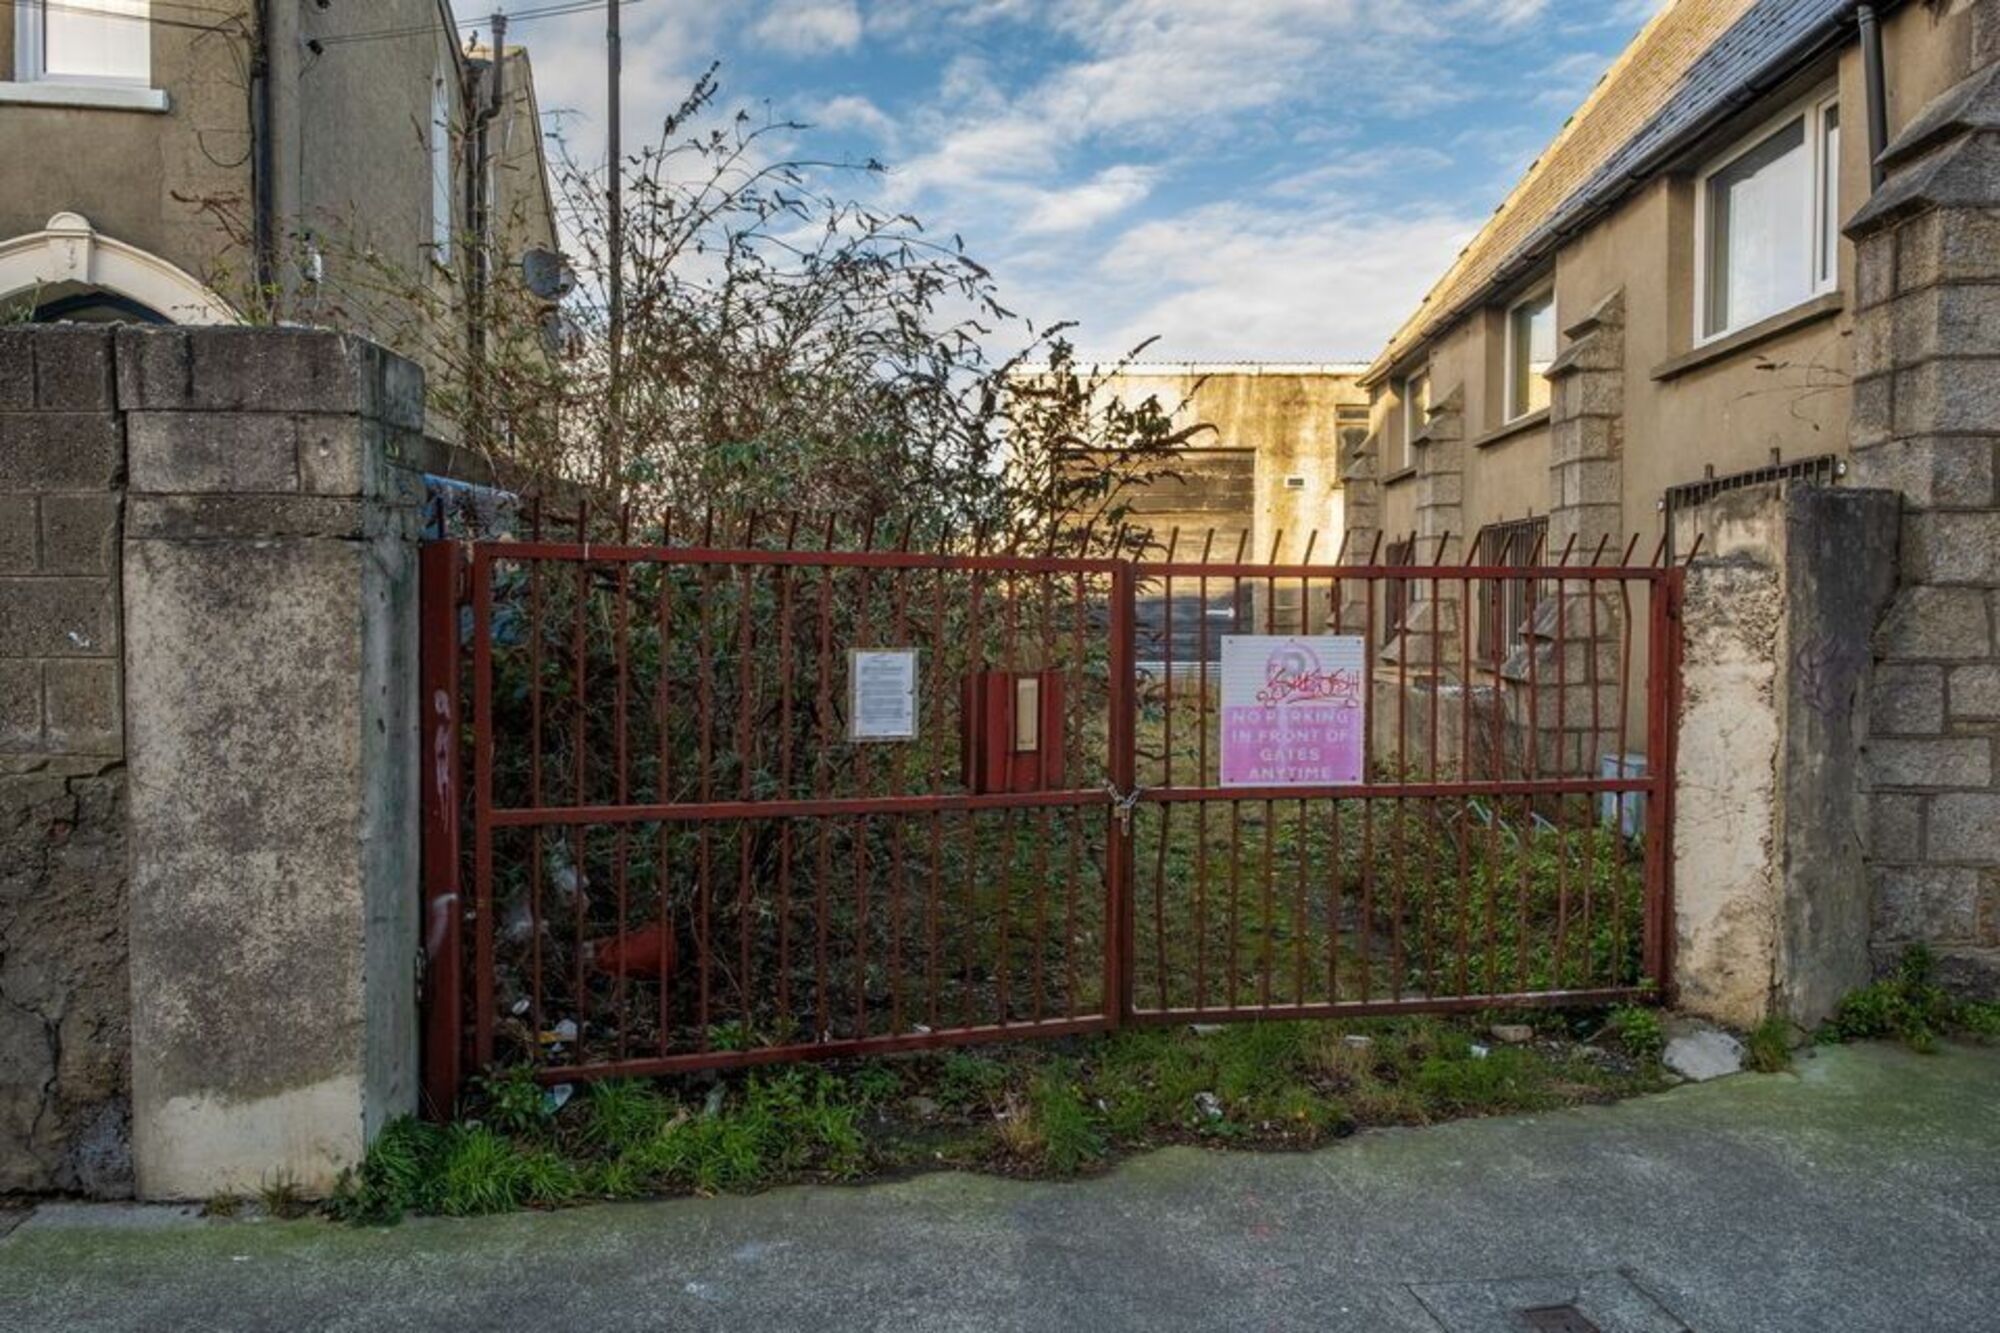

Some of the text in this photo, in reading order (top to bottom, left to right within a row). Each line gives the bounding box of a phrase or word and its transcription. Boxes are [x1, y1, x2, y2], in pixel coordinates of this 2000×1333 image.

[1232, 710, 1261, 724] NO
[1232, 729, 1349, 743] IN FRONT OF
[1259, 747, 1321, 761] GATES
[1248, 766, 1332, 779] ANYTIME
